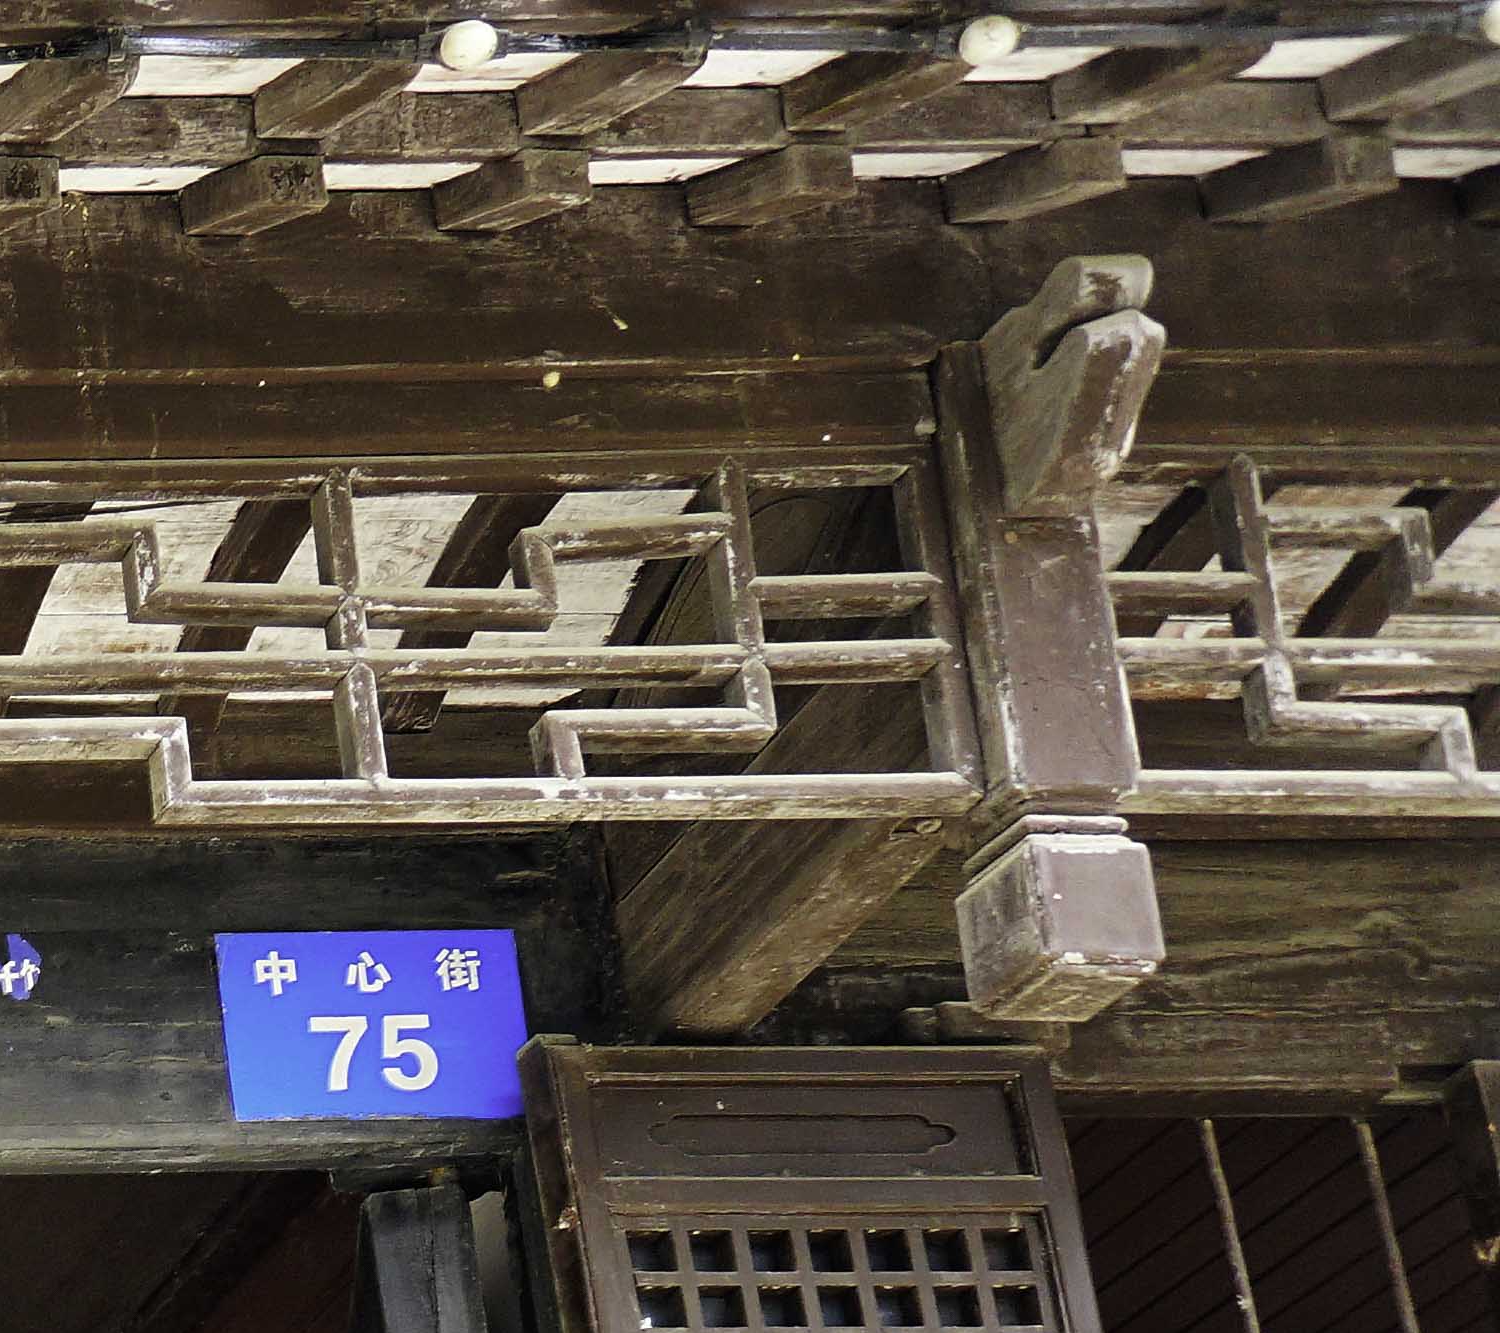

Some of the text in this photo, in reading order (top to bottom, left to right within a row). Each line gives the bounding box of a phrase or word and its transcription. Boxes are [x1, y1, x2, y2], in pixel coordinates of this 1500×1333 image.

[254, 948, 482, 996] 中心街
[308, 1013, 440, 1092] 75
